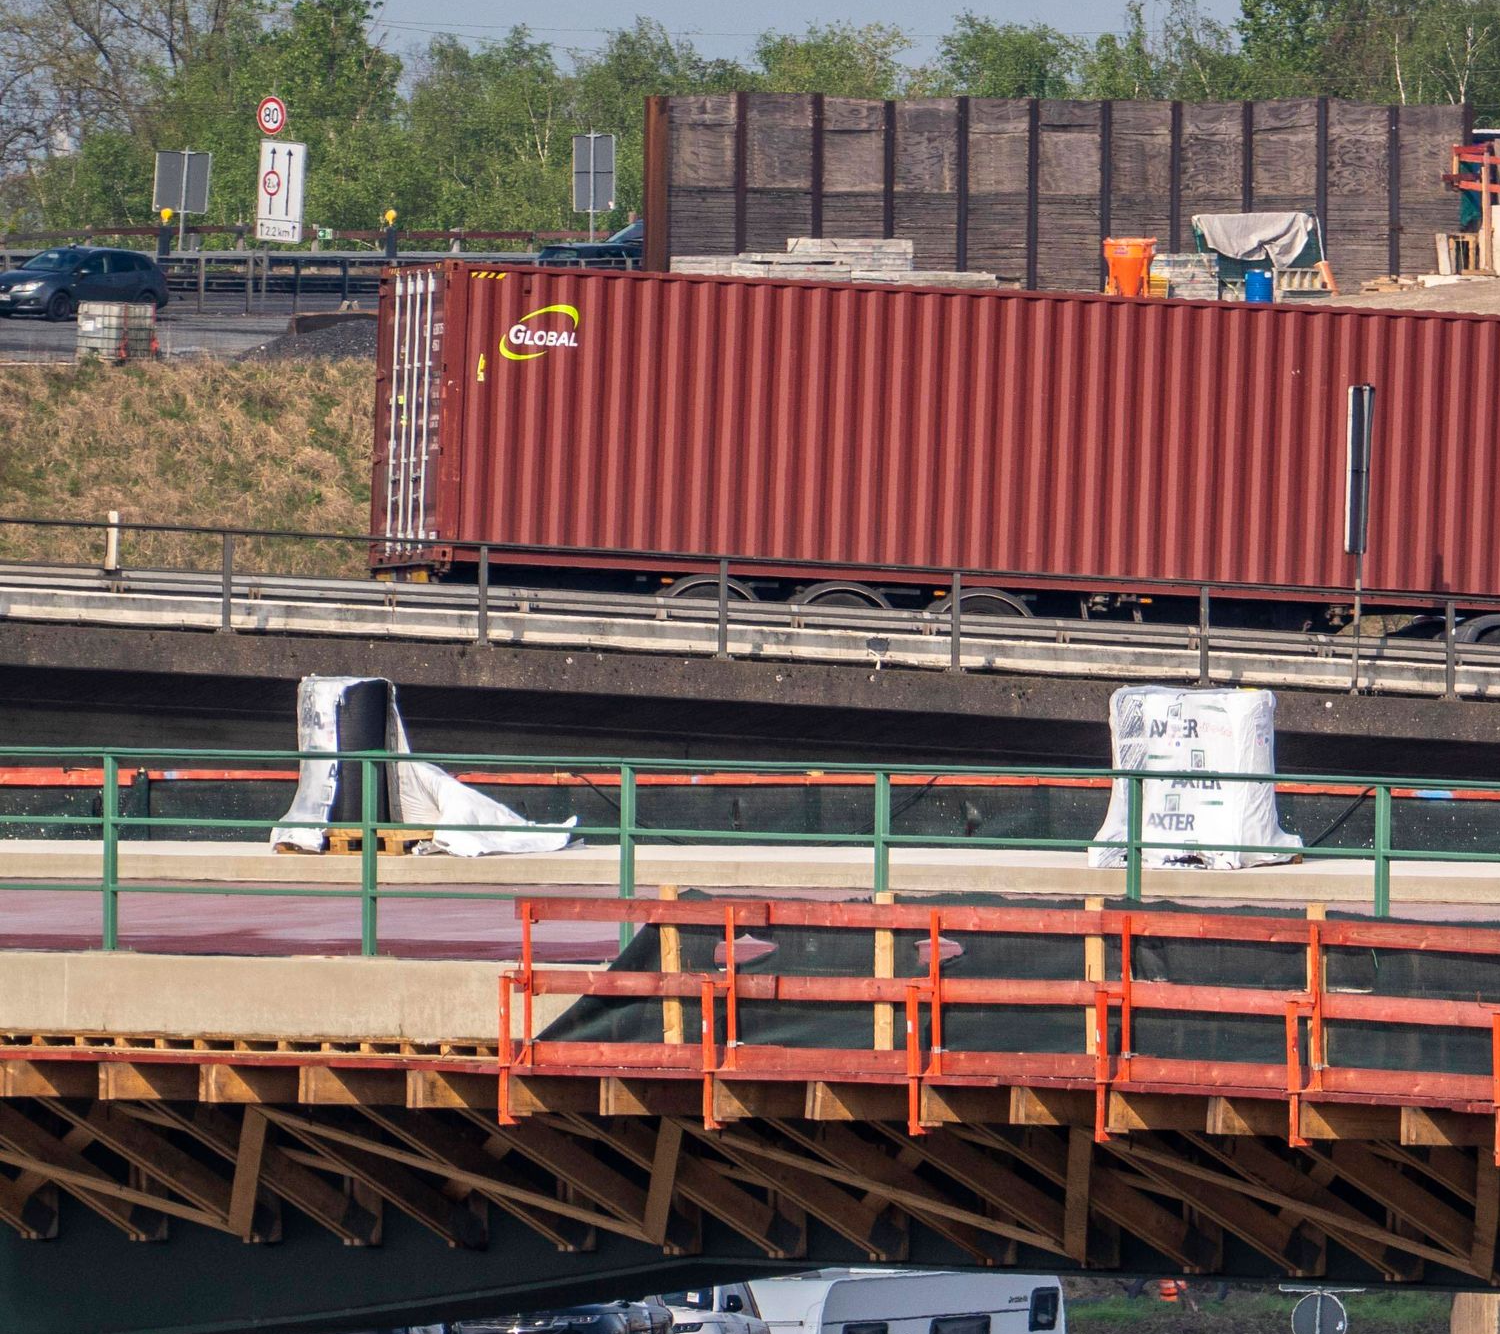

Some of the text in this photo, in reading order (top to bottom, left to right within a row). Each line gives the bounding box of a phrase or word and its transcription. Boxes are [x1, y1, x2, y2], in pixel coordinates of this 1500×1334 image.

[263, 107, 279, 124] 80
[508, 323, 580, 348] GLOBAL
[1147, 813, 1195, 832] AXTER
